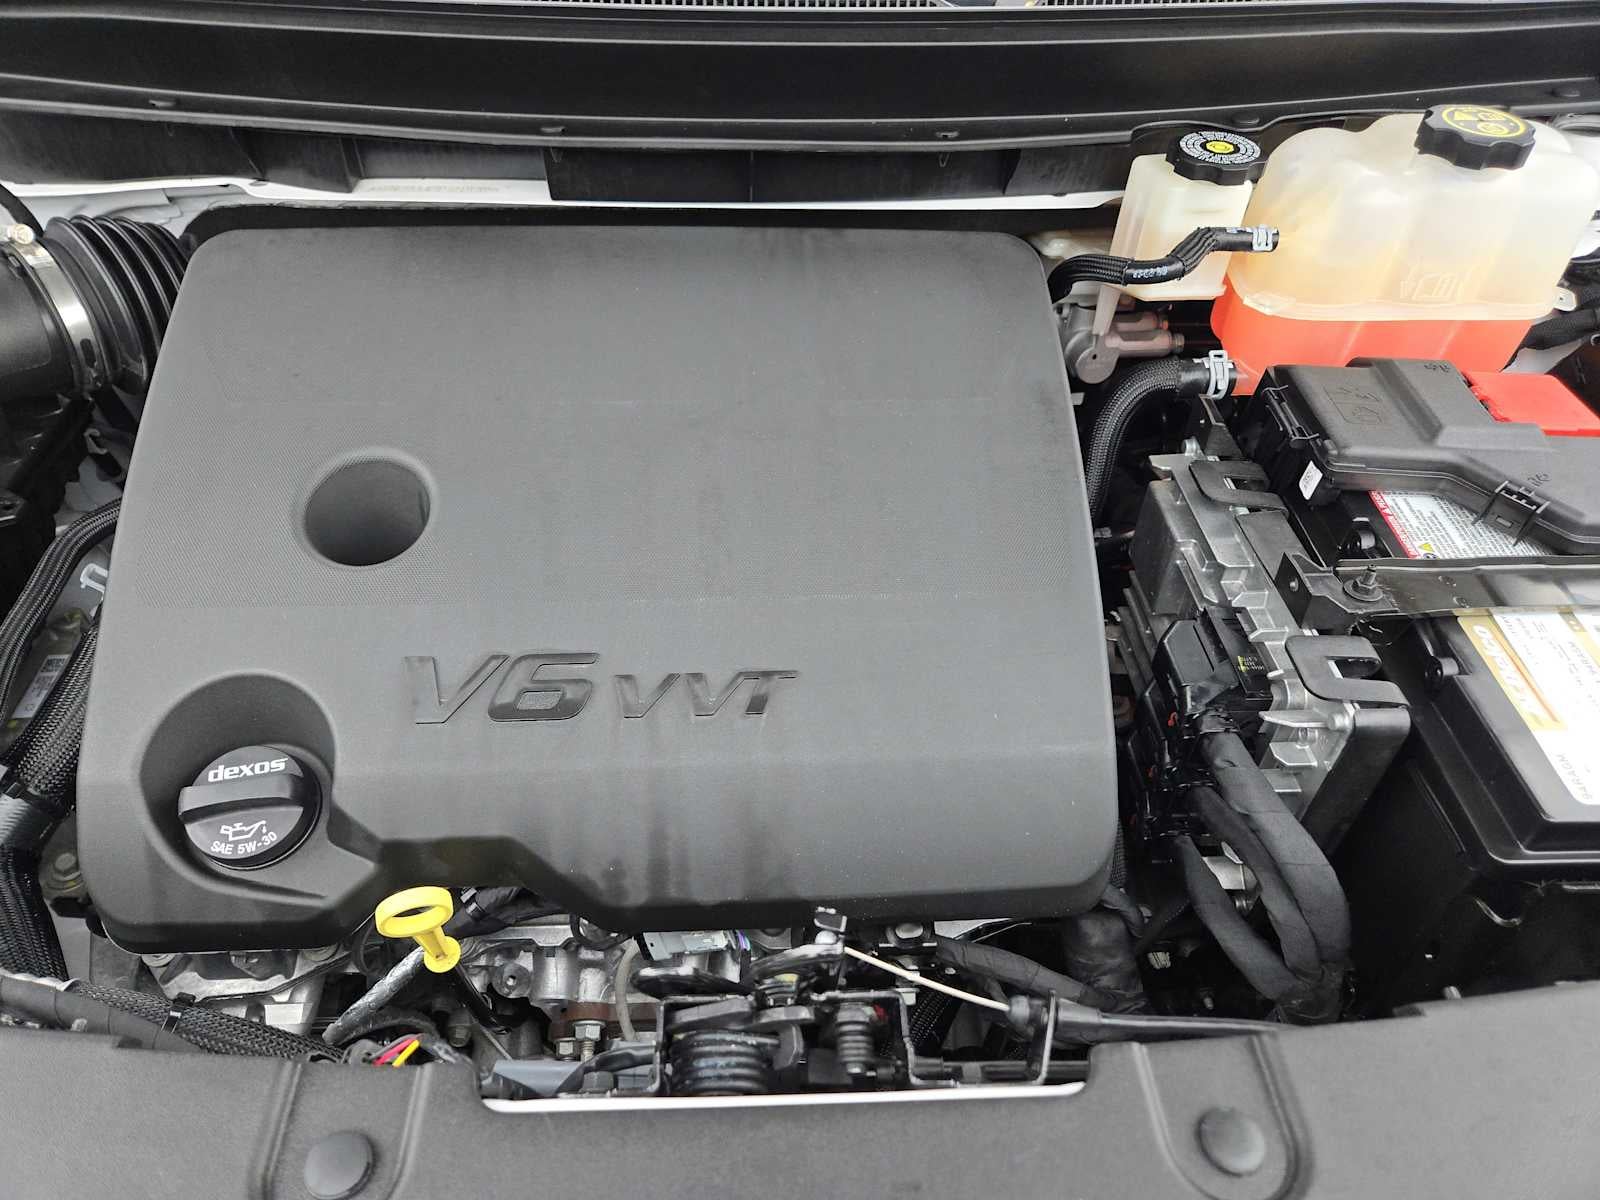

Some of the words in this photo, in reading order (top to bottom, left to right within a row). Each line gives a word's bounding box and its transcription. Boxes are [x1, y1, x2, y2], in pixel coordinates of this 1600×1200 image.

[404, 652, 600, 724] V6
[614, 669, 799, 718] VVT
[207, 757, 289, 783] dexos
[210, 840, 235, 855] SAE
[237, 831, 278, 855] 5W-30
